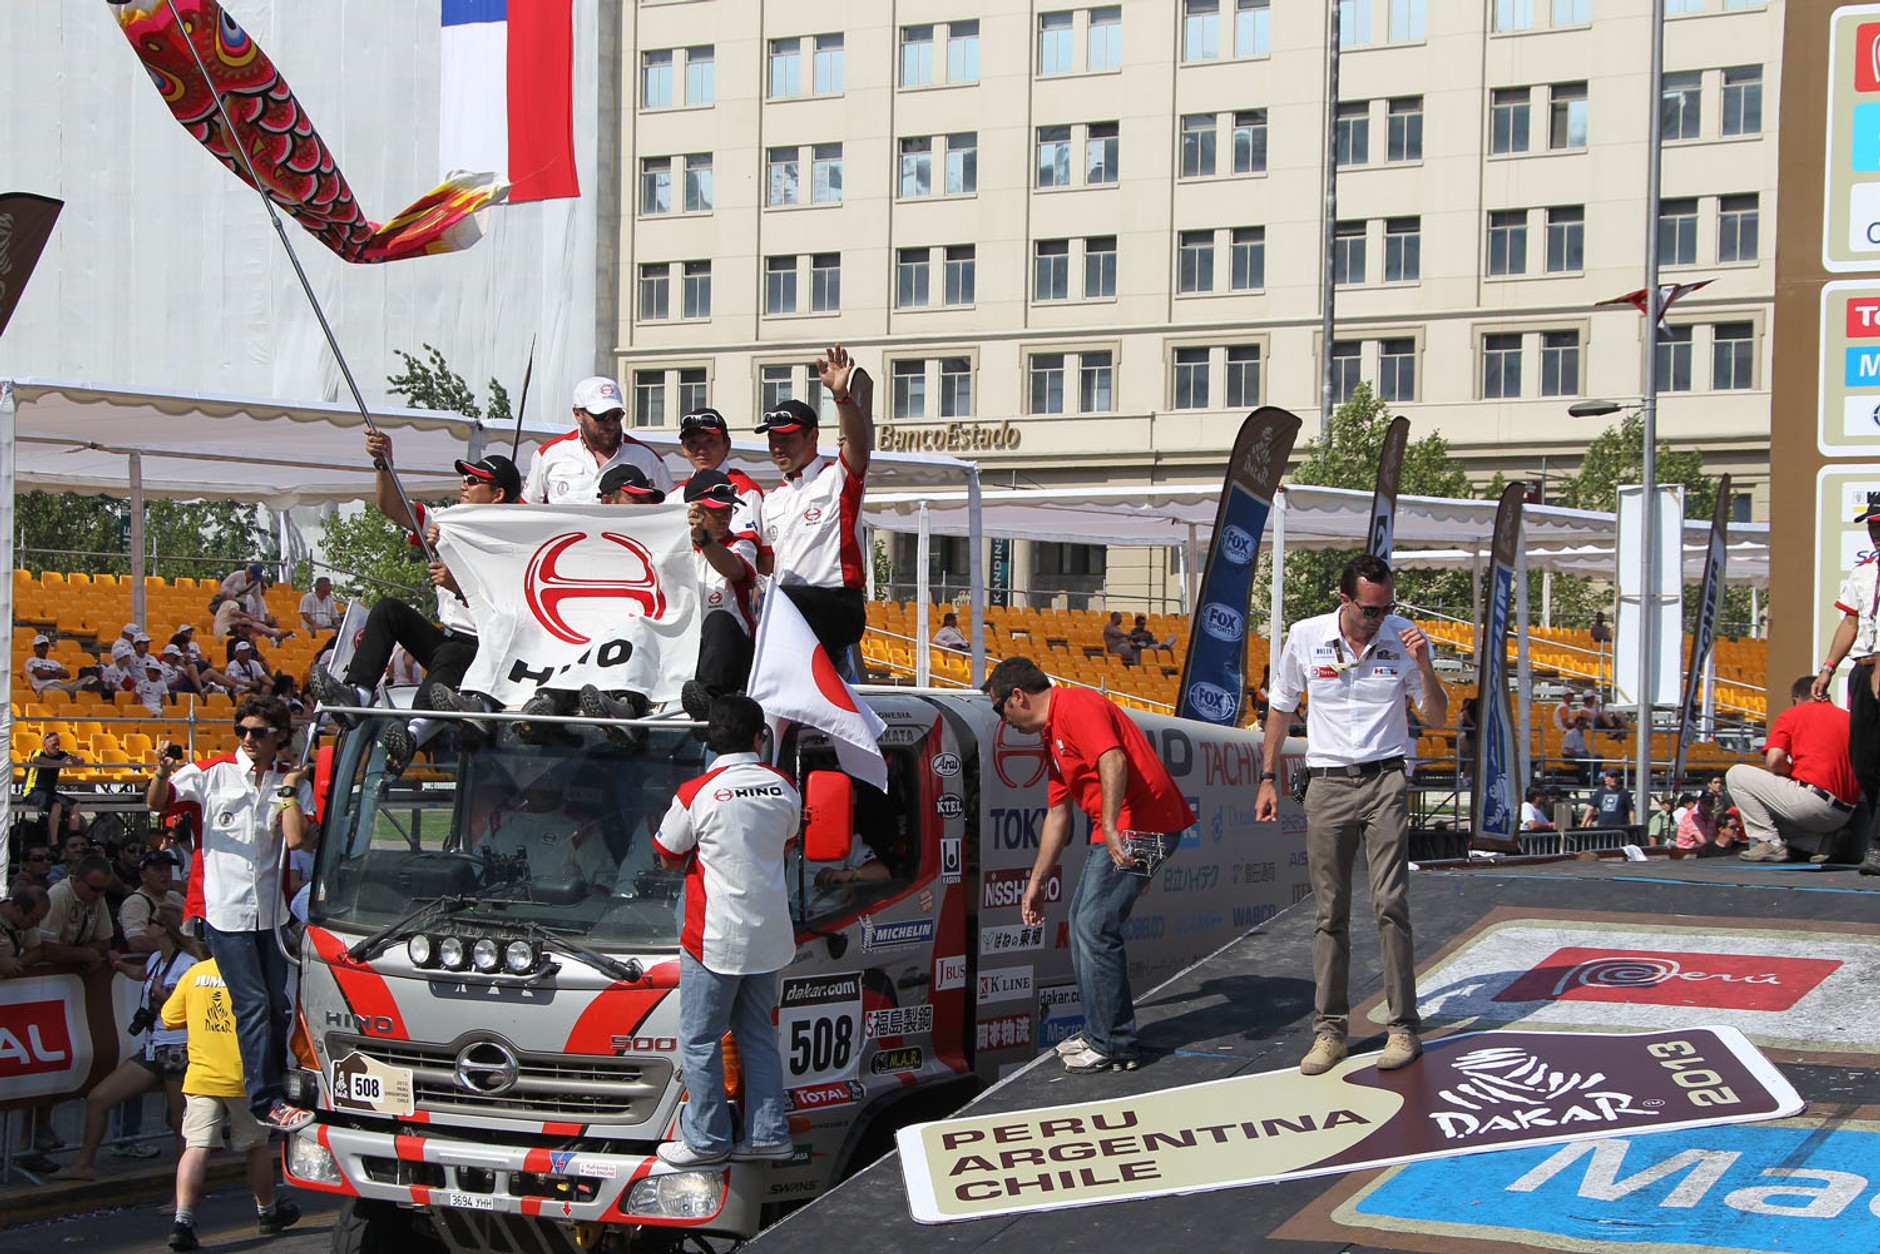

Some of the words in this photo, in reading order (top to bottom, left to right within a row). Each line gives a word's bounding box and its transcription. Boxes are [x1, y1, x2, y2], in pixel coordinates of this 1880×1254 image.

[878, 421, 1022, 451] BancoEstado
[1228, 530, 1250, 554] FOX
[1210, 608, 1237, 631] FOX
[1199, 687, 1223, 709] FOX
[935, 756, 958, 769] Arai
[735, 787, 783, 797] HINO
[936, 801, 963, 813] KTEL
[876, 924, 931, 941] MICHELIN
[786, 981, 855, 1000] dakar.com
[1003, 978, 1031, 991] LINE
[205, 1019, 232, 1033] DAKAR
[325, 1011, 393, 1033] HINO
[610, 1035, 677, 1051] 500
[789, 1015, 854, 1075] 508
[1646, 1040, 1742, 1107] 2013
[355, 1077, 379, 1097] 508
[797, 1089, 848, 1104] TOTAL
[1429, 1092, 1660, 1139] DAKAR
[941, 1110, 1139, 1151] PERU
[948, 1109, 1372, 1177] ARGENTINA
[768, 1181, 816, 1194] SWANS
[955, 1160, 1162, 1201] CHILE
[1505, 1139, 1880, 1219] Ma
[452, 1195, 472, 1206] 3694
